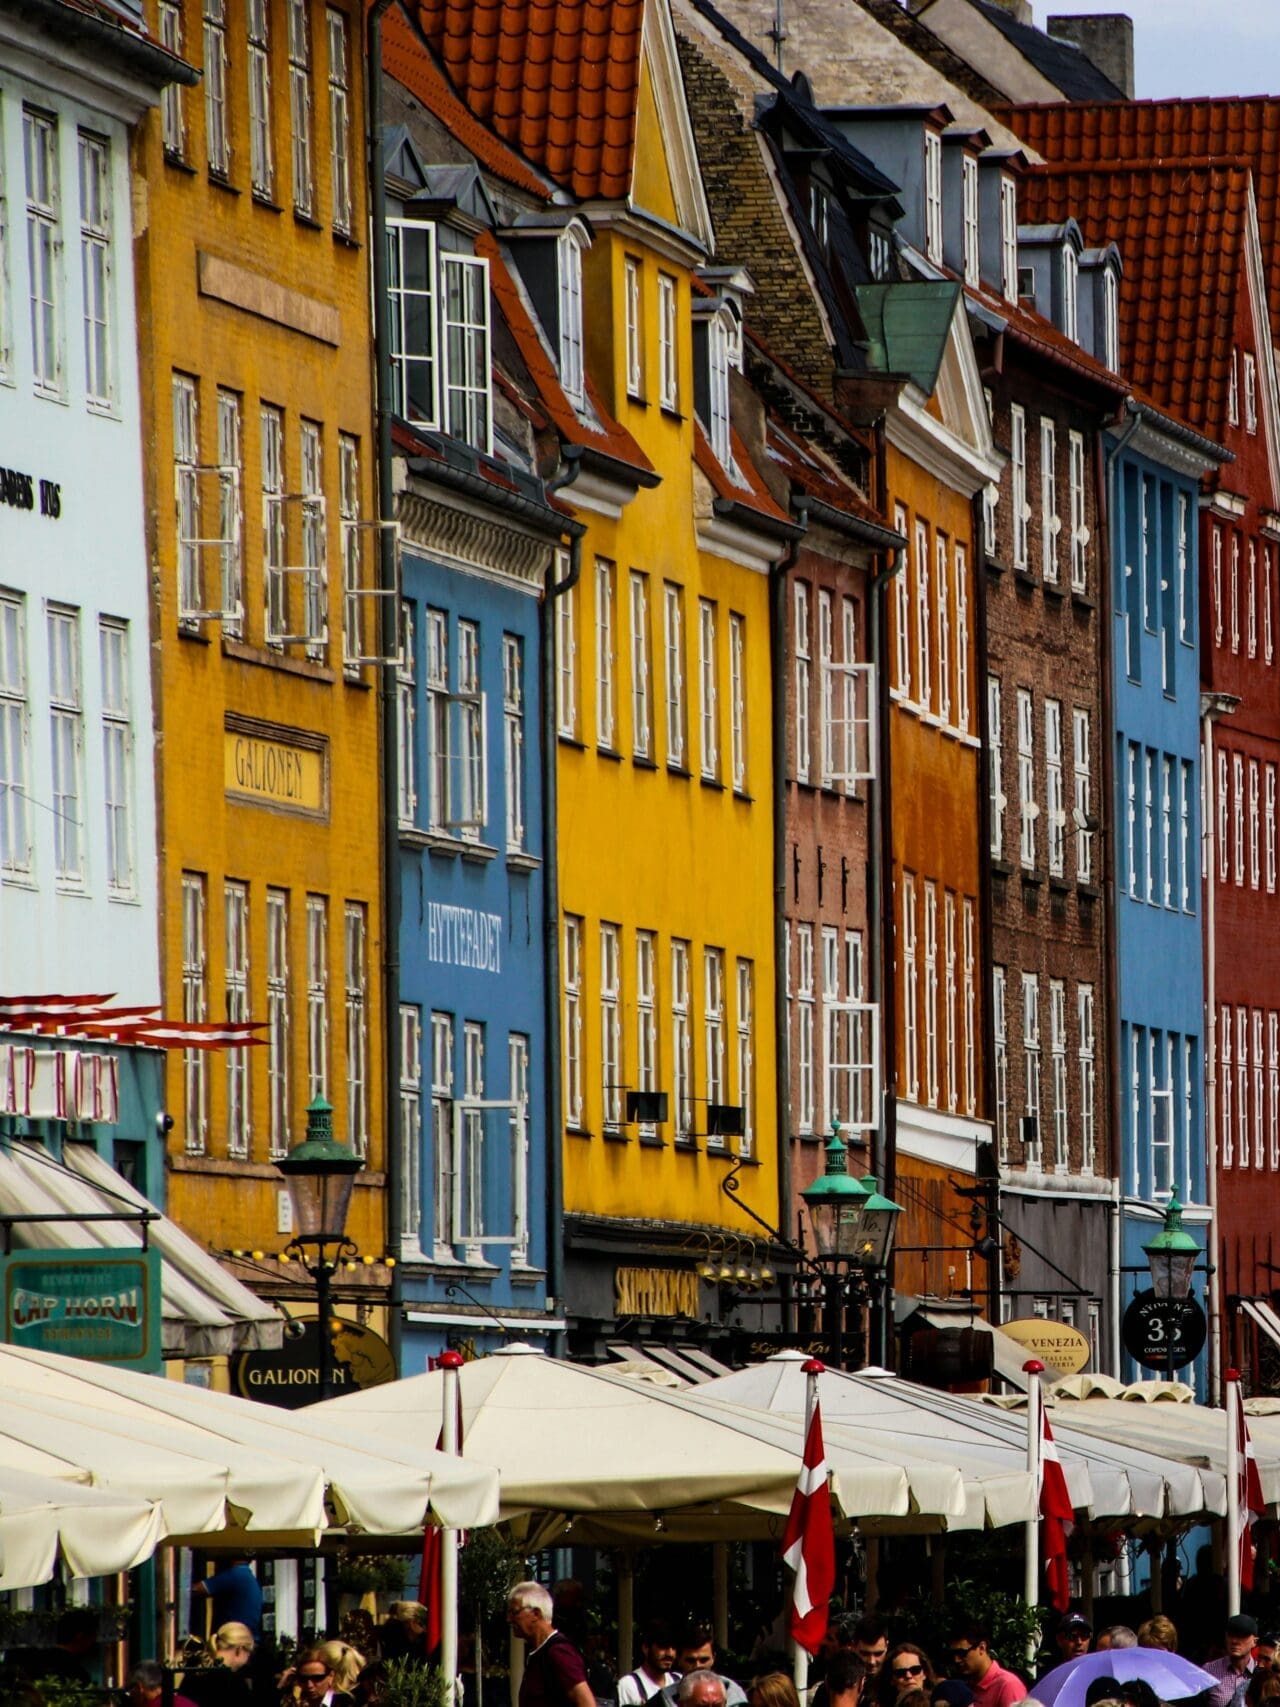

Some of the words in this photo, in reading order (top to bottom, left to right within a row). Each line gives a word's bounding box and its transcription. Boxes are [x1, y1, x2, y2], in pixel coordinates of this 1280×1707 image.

[40, 479, 61, 520] HUS
[235, 738, 302, 799] GALIONEN
[428, 902, 502, 974] HYTTEFADET
[13, 1291, 58, 1325] CAP
[64, 1288, 138, 1324] HORN
[1031, 1337, 1083, 1347] VENEZIA
[249, 1369, 345, 1385] GALIONN
